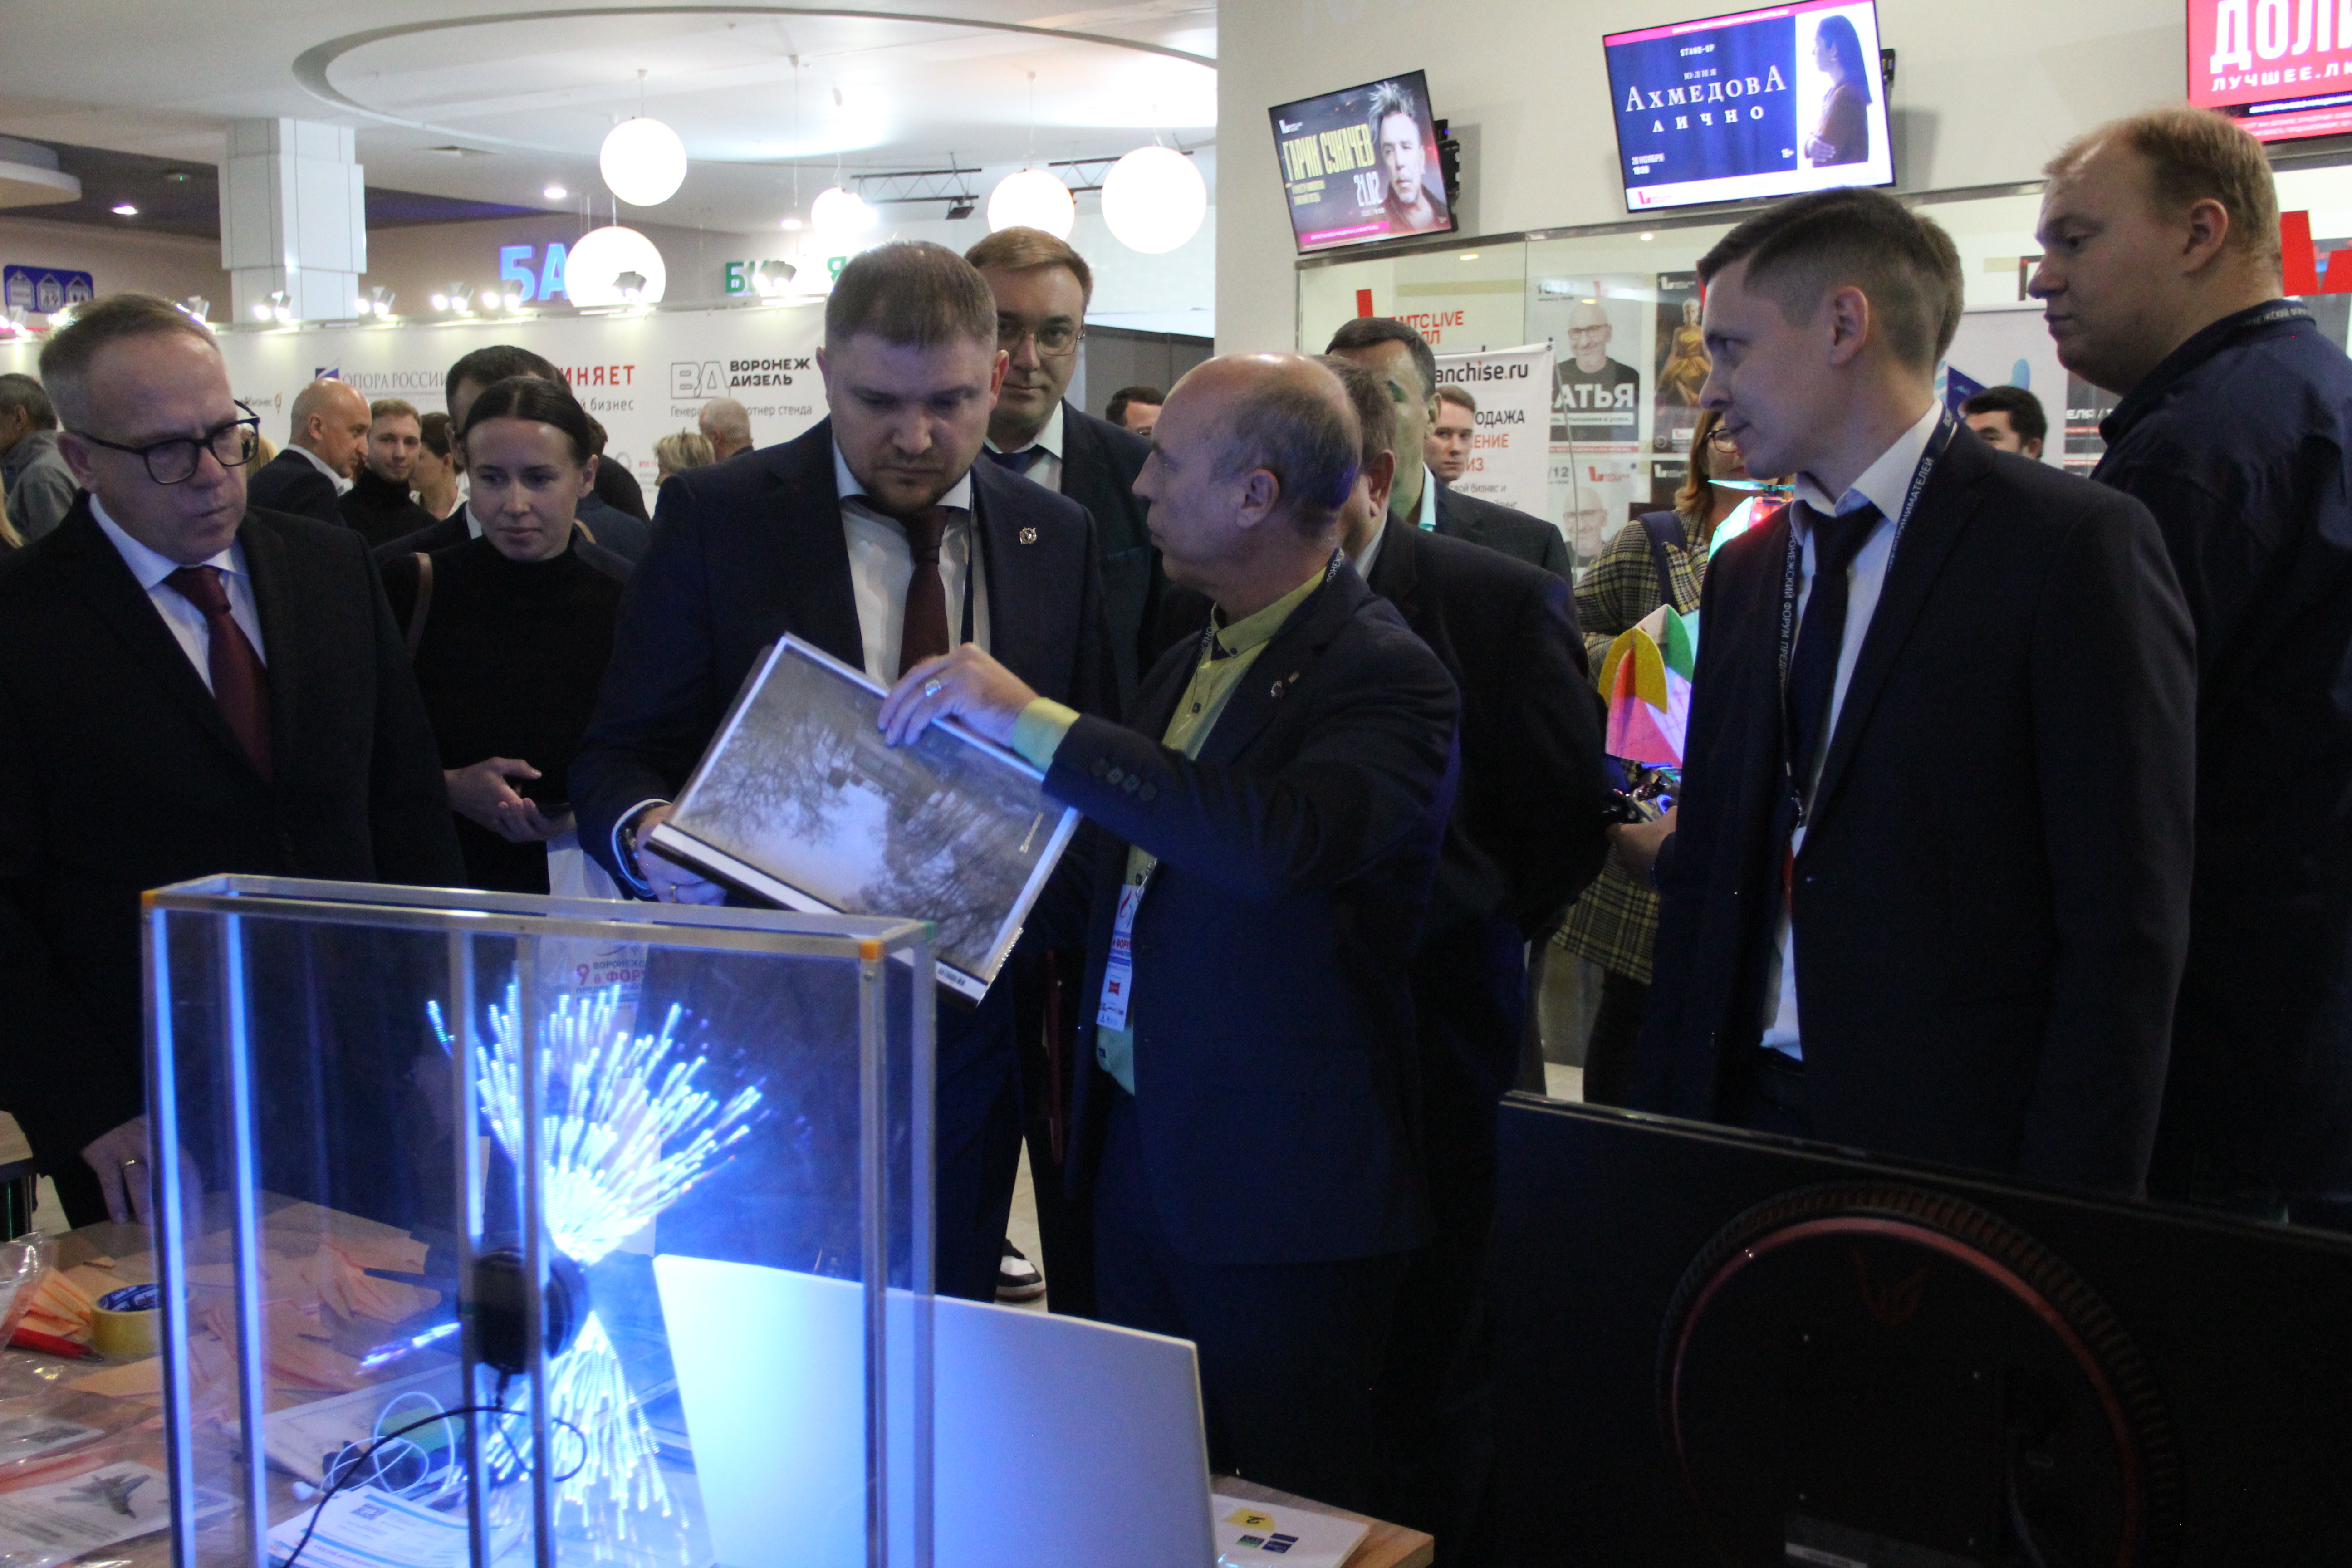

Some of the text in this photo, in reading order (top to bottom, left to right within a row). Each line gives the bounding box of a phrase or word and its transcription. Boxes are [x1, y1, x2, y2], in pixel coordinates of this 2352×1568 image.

[2210, 0, 2352, 74] ДОЛ
[1680, 44, 1715, 57] STAND-UP
[1684, 68, 1717, 80] ЮЛИЯ
[1282, 123, 1376, 181] ГАРИК СУКАЧЕВ
[1639, 153, 1665, 164] НОЯБРЯ
[1432, 310, 1464, 328] LIVE
[1421, 330, 1440, 345] ЛЛ
[730, 358, 811, 372] ВОРОНЕЖ
[1436, 361, 1528, 383] anchise.ru
[343, 372, 390, 389] ОПОРА
[560, 365, 635, 387] ИНЯЕТ
[730, 374, 793, 387] ДИЗЕЛЬ
[1553, 383, 1635, 408] АТЬЯ
[591, 397, 634, 411] бизнес
[671, 406, 812, 418] Генера ртнер стенда
[1475, 410, 1525, 428] ОДАЖА
[1474, 433, 1509, 449] ЕНИЕ
[1465, 457, 1484, 472] ИЗ
[1471, 484, 1499, 493] бизнес
[1784, 529, 1796, 598] РОНЕЖСКИЙ
[1781, 602, 1792, 638] ФОРУМ
[593, 960, 646, 969] ВОРОНЕЖС
[577, 964, 590, 985] 9
